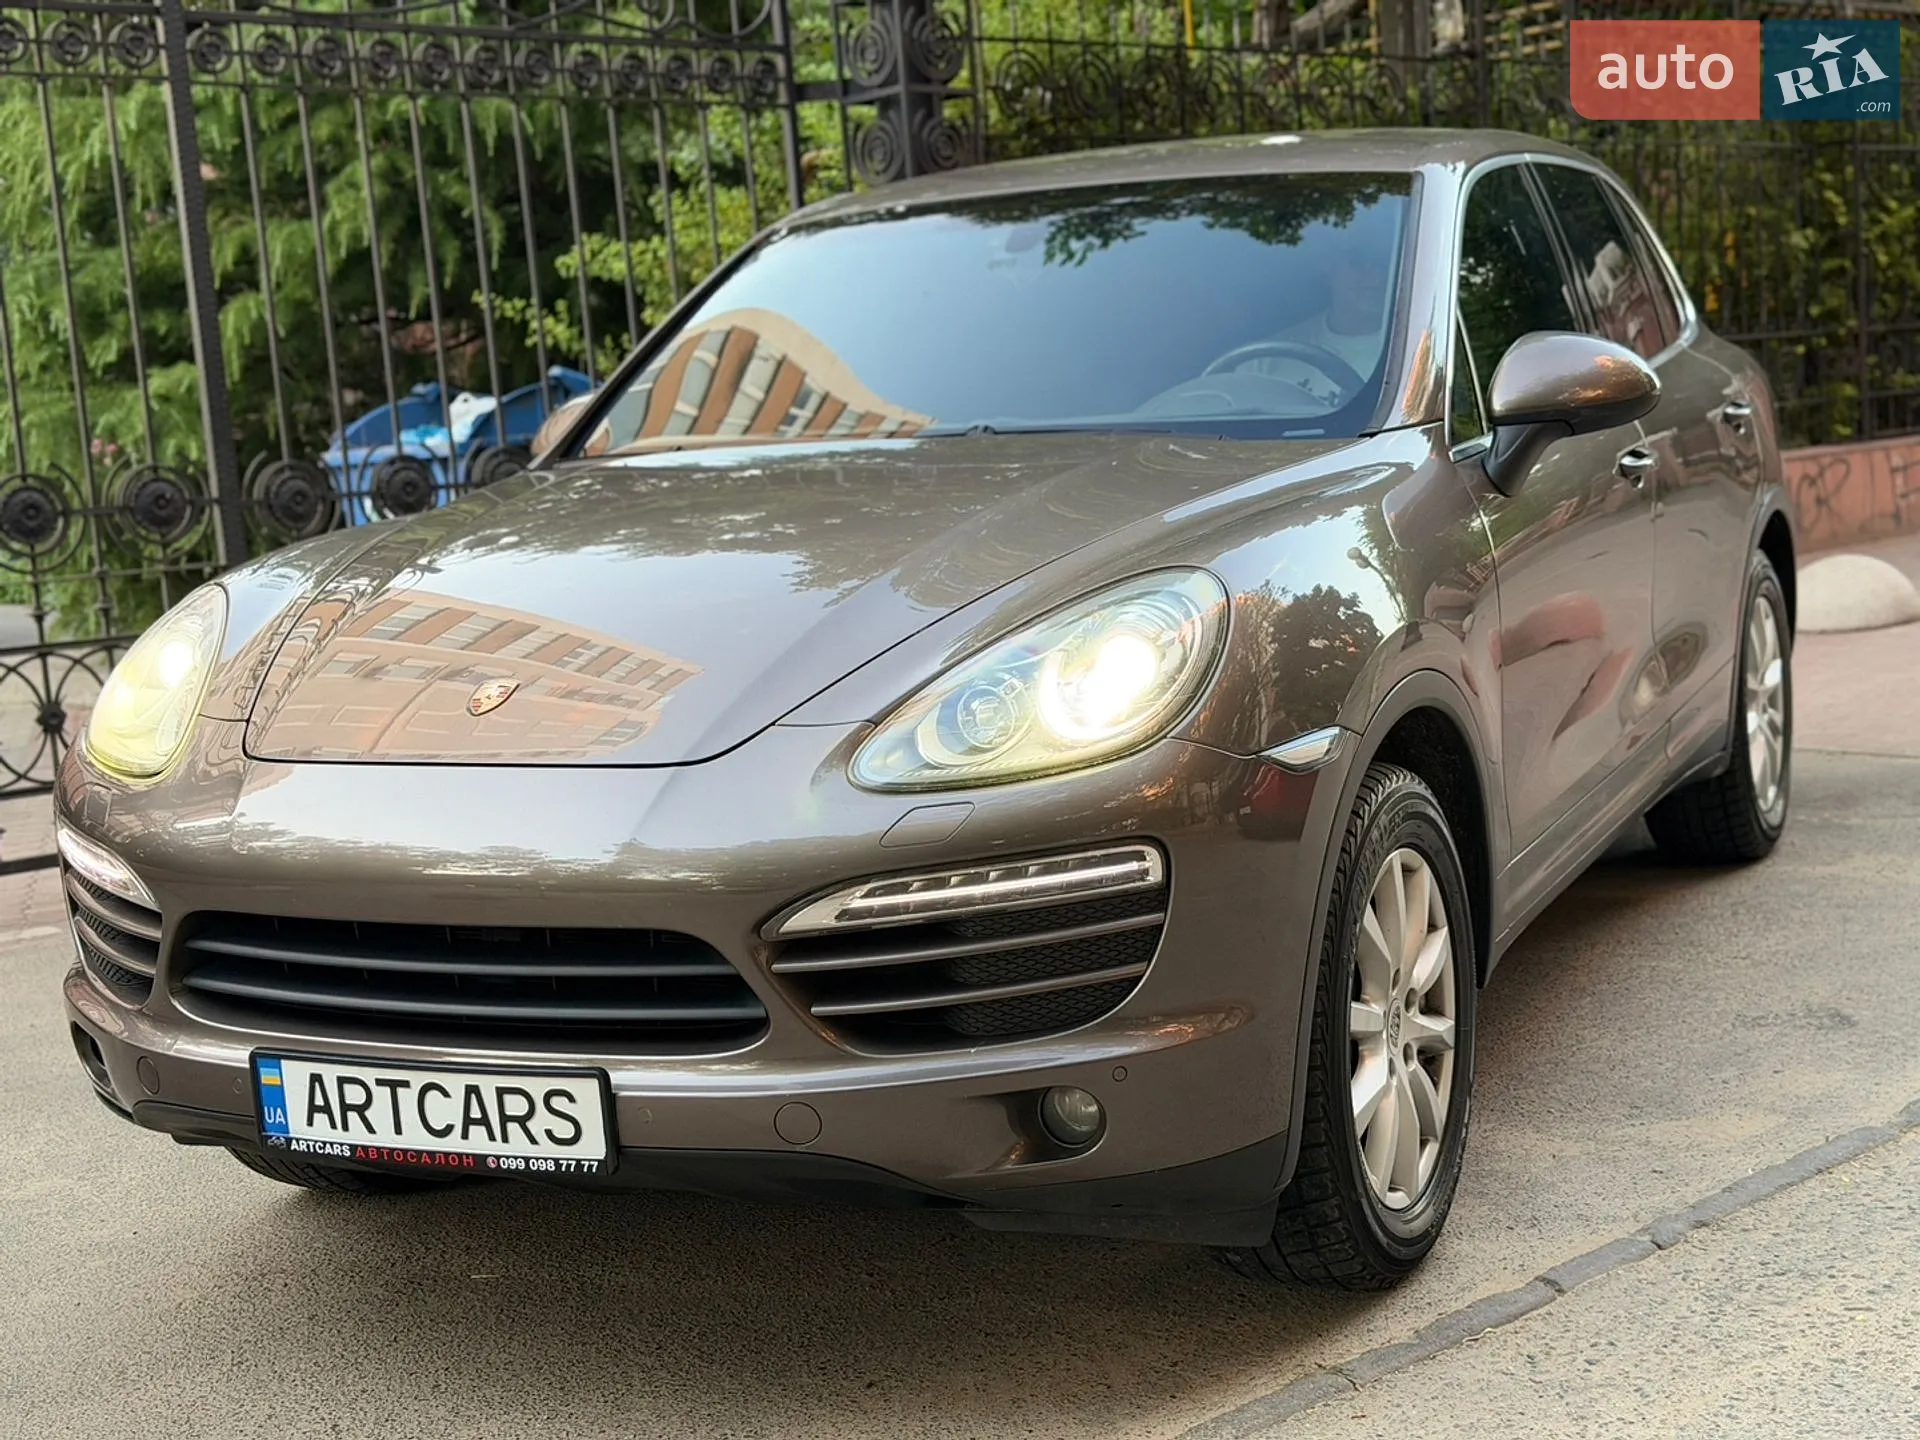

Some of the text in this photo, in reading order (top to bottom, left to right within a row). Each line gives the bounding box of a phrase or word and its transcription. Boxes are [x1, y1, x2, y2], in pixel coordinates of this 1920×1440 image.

[264, 1106, 286, 1125] UA
[306, 1072, 583, 1147] ARTCARS
[290, 1139, 350, 1157] ARTCARS
[355, 1146, 475, 1168] АВТОСАЛОН
[500, 1157, 598, 1172] 099 098 77 77
